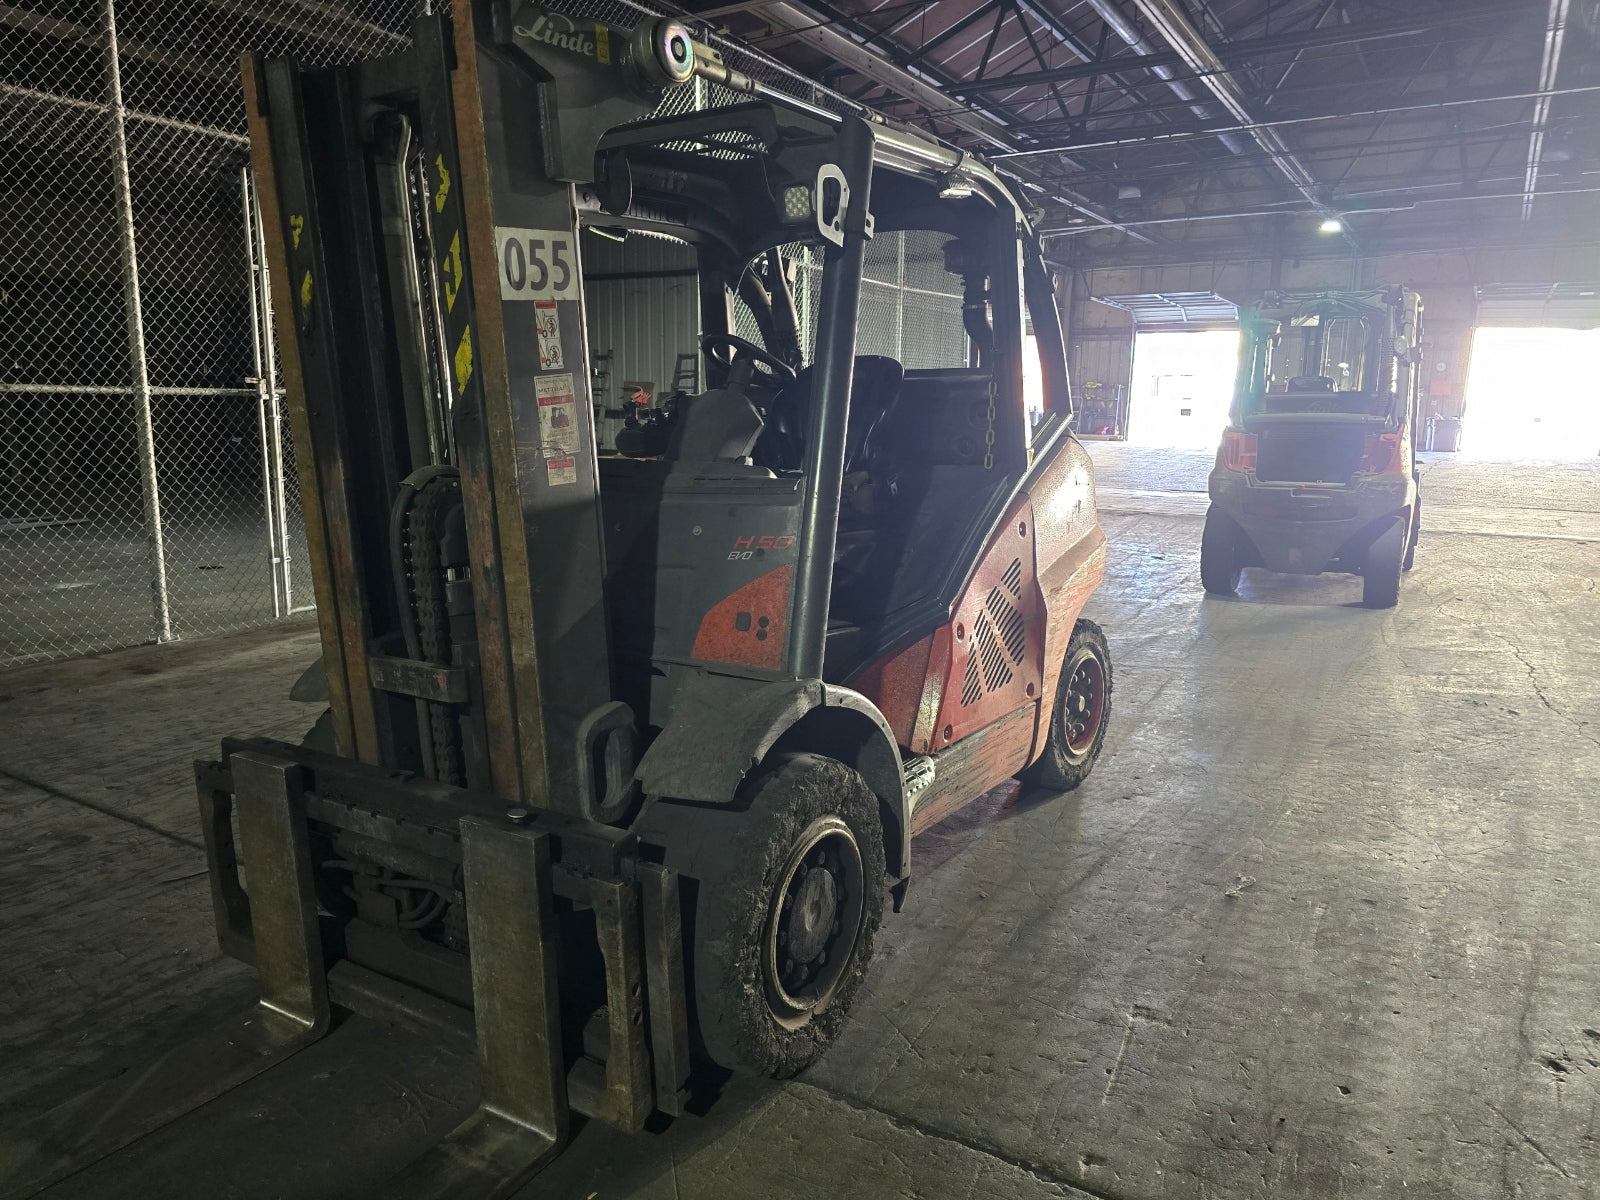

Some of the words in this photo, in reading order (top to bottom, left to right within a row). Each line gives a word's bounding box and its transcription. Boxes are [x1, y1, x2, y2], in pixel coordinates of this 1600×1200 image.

[514, 12, 595, 56] Linde
[504, 237, 571, 292] 055
[727, 551, 753, 560] EVO
